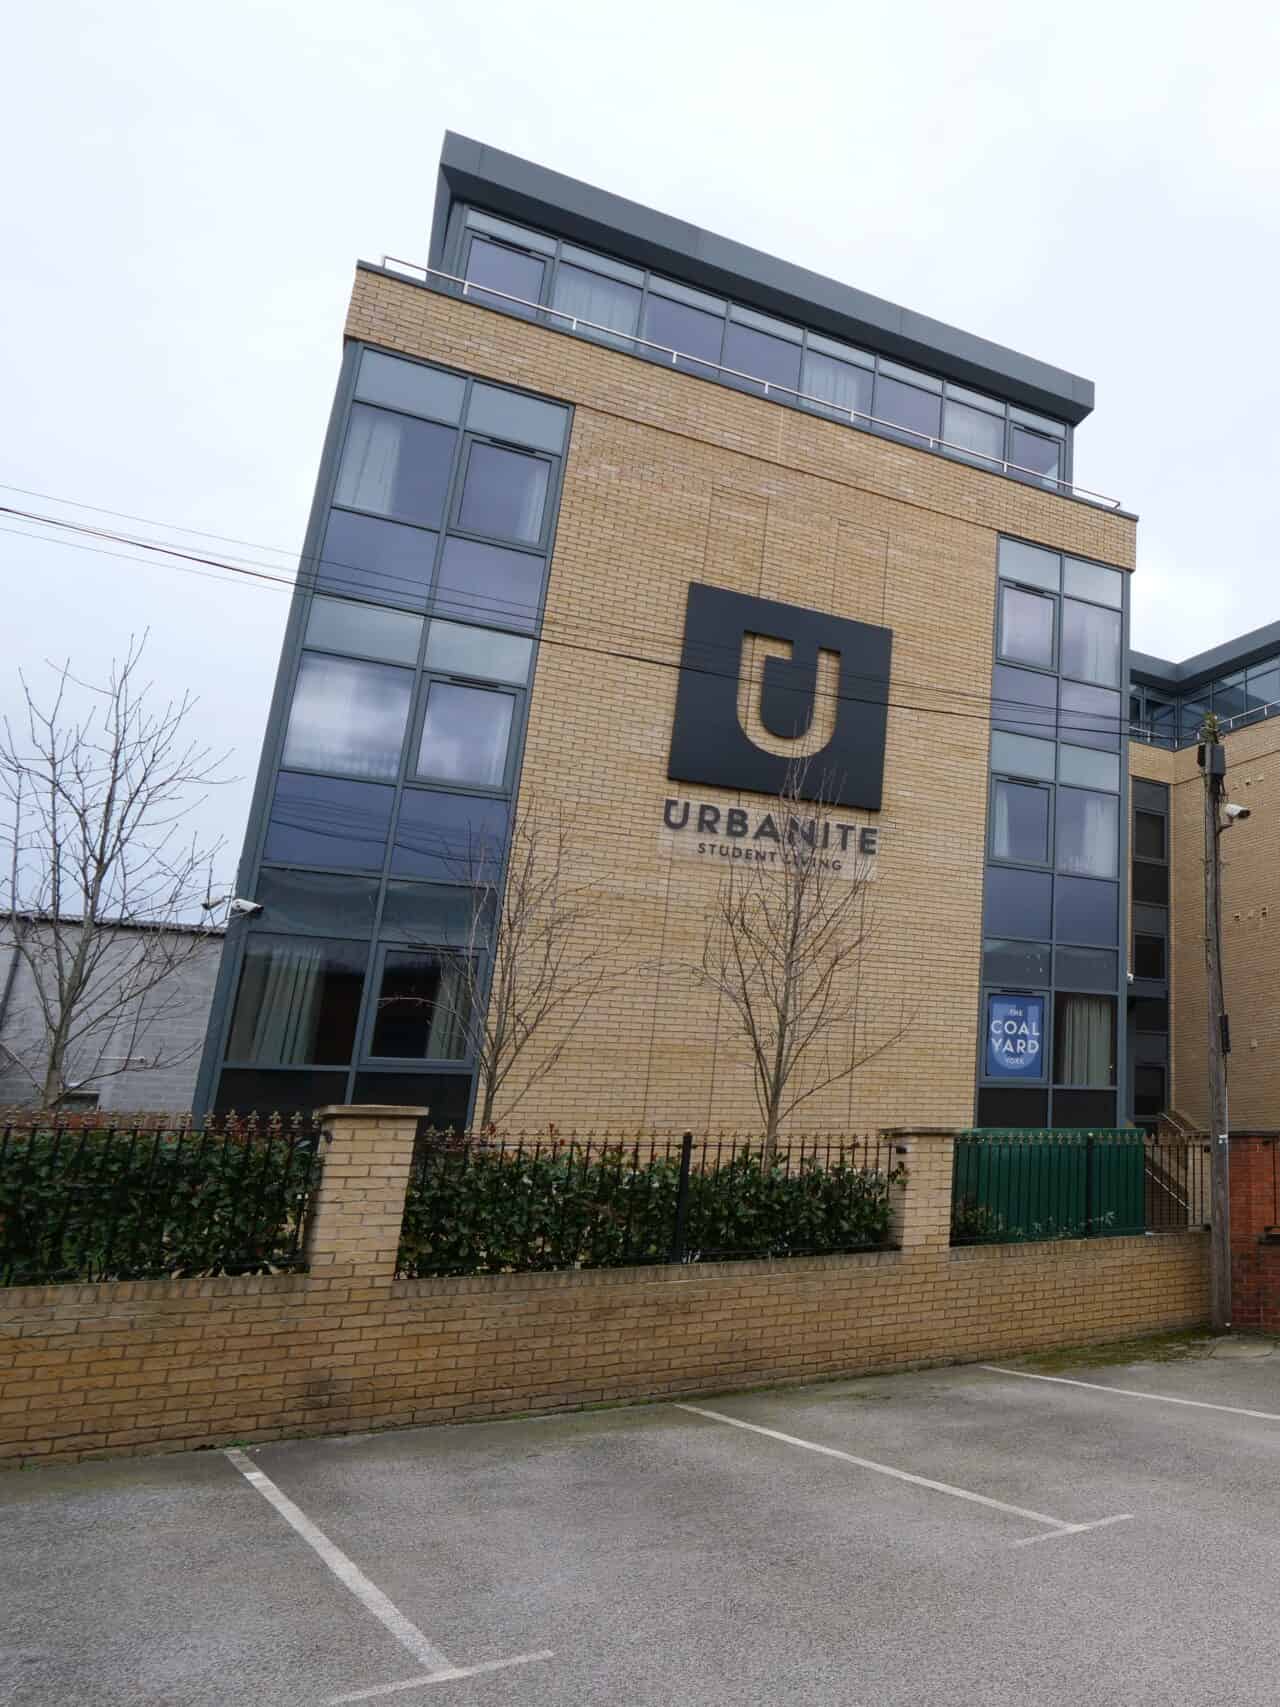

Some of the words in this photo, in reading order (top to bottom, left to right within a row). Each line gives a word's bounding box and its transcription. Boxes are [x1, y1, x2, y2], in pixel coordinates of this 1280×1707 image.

[663, 800, 878, 855] URBANITE
[697, 842, 778, 863] STUDENT
[1008, 1008, 1024, 1017] THE
[991, 1020, 1041, 1036] COAL
[991, 1038, 1040, 1054] YARD
